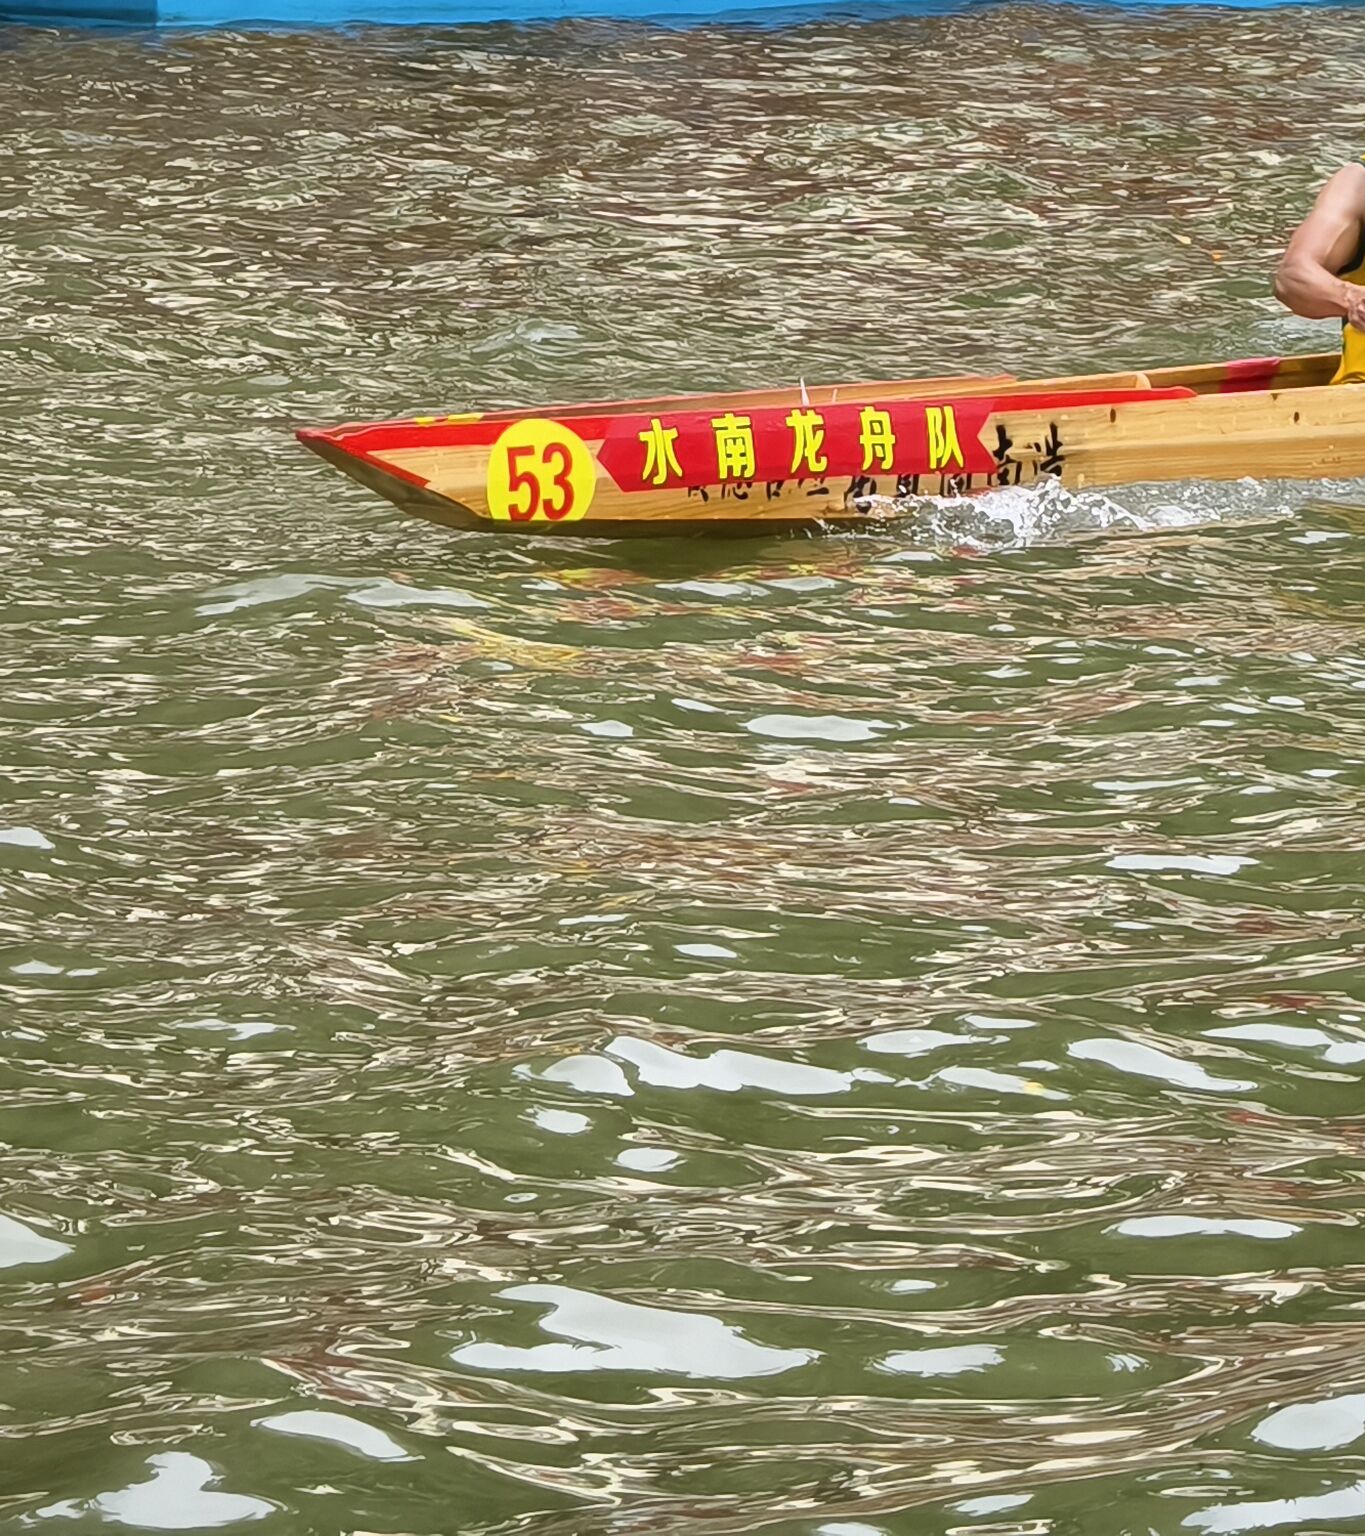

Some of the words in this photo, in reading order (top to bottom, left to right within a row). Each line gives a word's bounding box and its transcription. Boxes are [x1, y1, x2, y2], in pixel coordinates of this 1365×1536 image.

[505, 442, 575, 523] 53
[639, 405, 966, 486] 水南龙舟队
